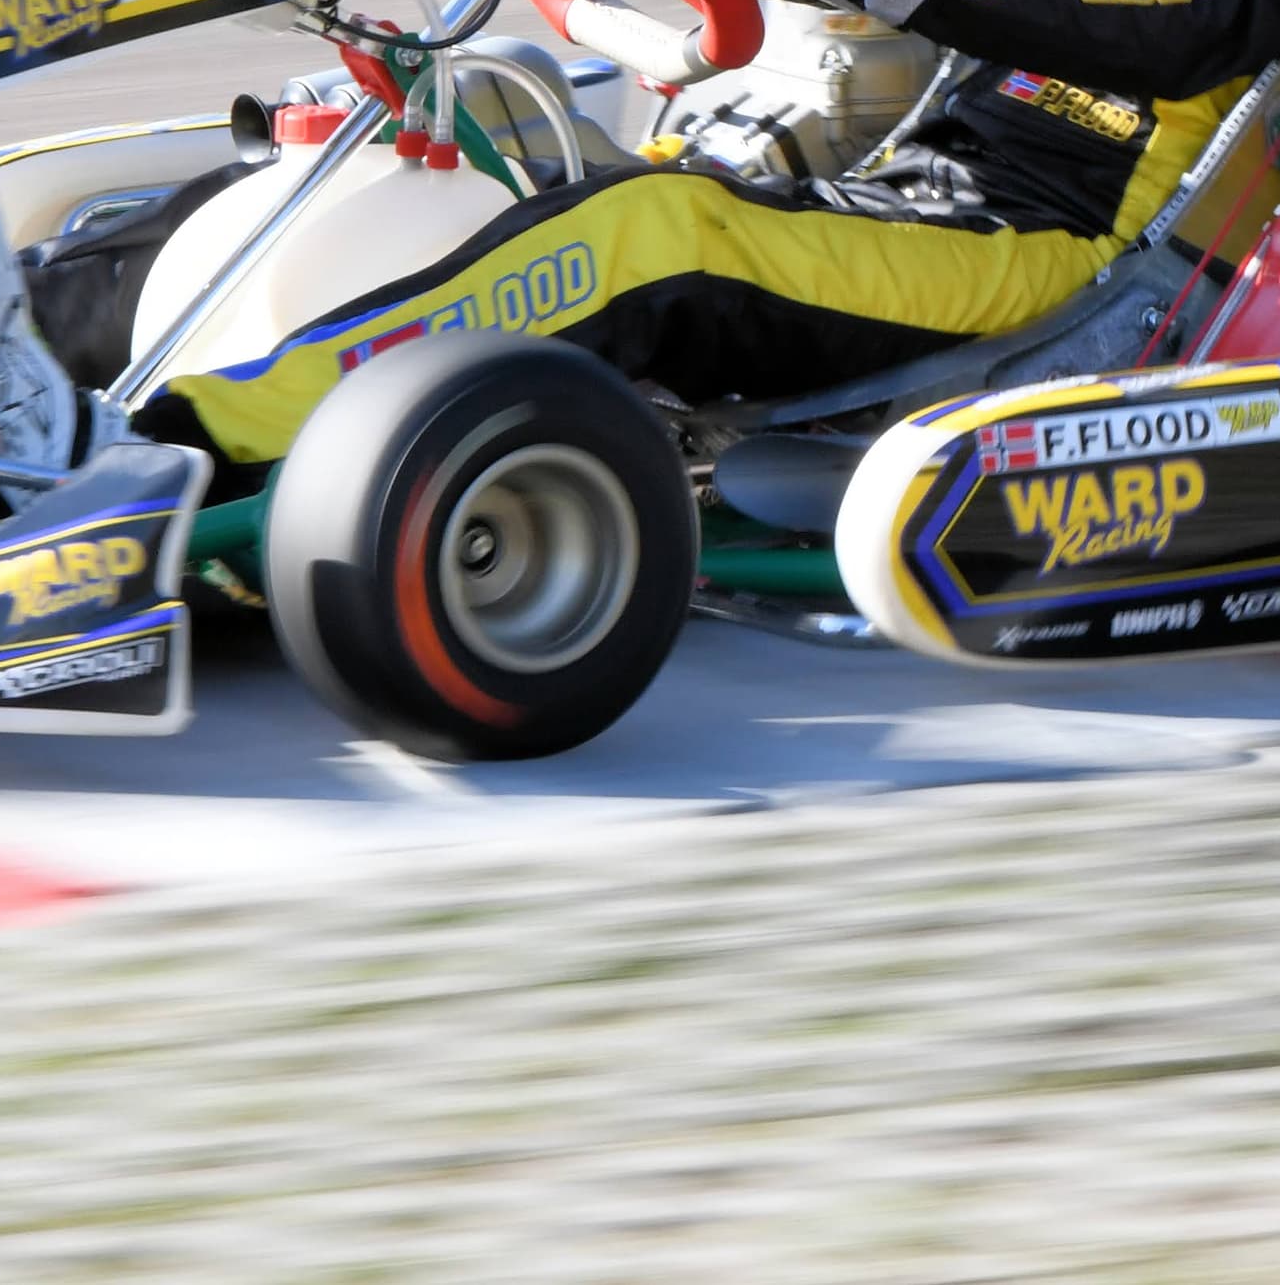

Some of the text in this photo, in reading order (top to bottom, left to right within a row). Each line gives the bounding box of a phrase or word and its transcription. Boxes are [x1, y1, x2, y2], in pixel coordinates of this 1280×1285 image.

[1043, 408, 1211, 458] F.FLOOD
[1002, 457, 1206, 539] WARD
[1038, 513, 1173, 577] Racing
